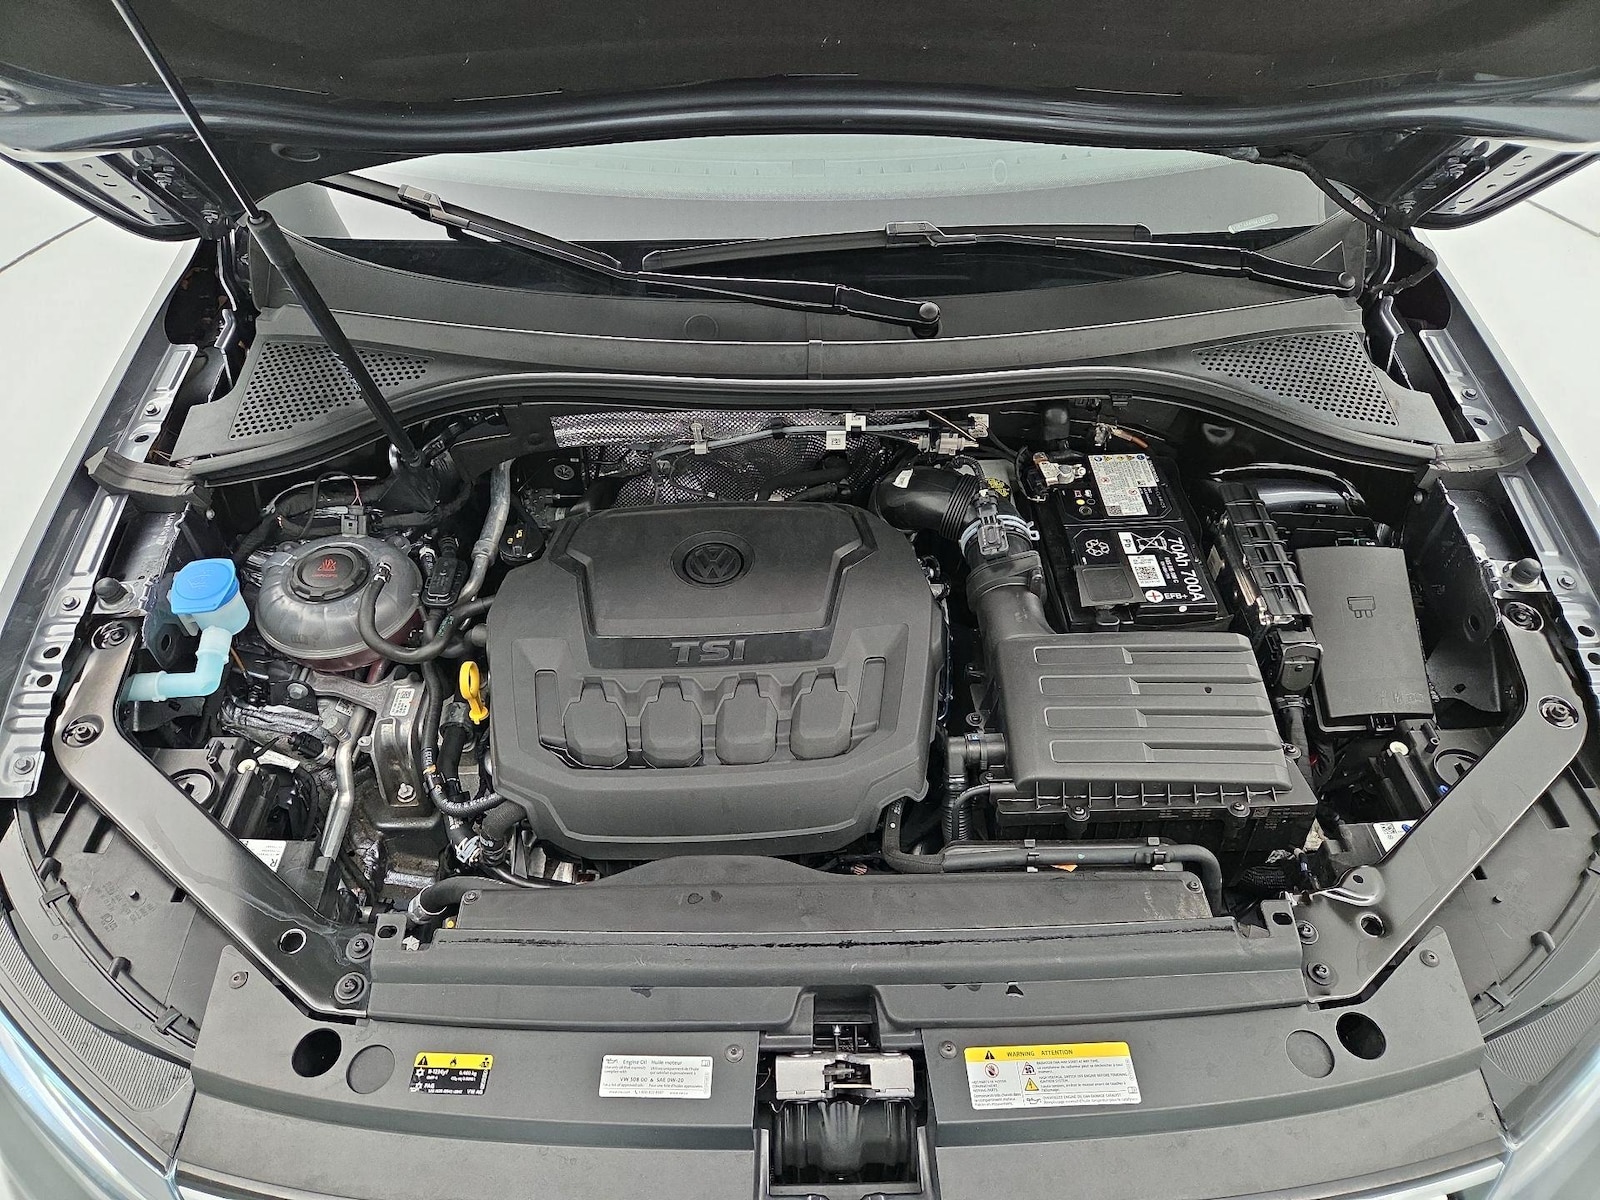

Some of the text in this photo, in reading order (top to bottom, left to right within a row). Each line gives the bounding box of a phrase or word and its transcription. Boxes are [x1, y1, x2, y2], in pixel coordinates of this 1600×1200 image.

[1168, 537, 1206, 601] 70Ah 700A
[670, 639, 746, 664] TSI
